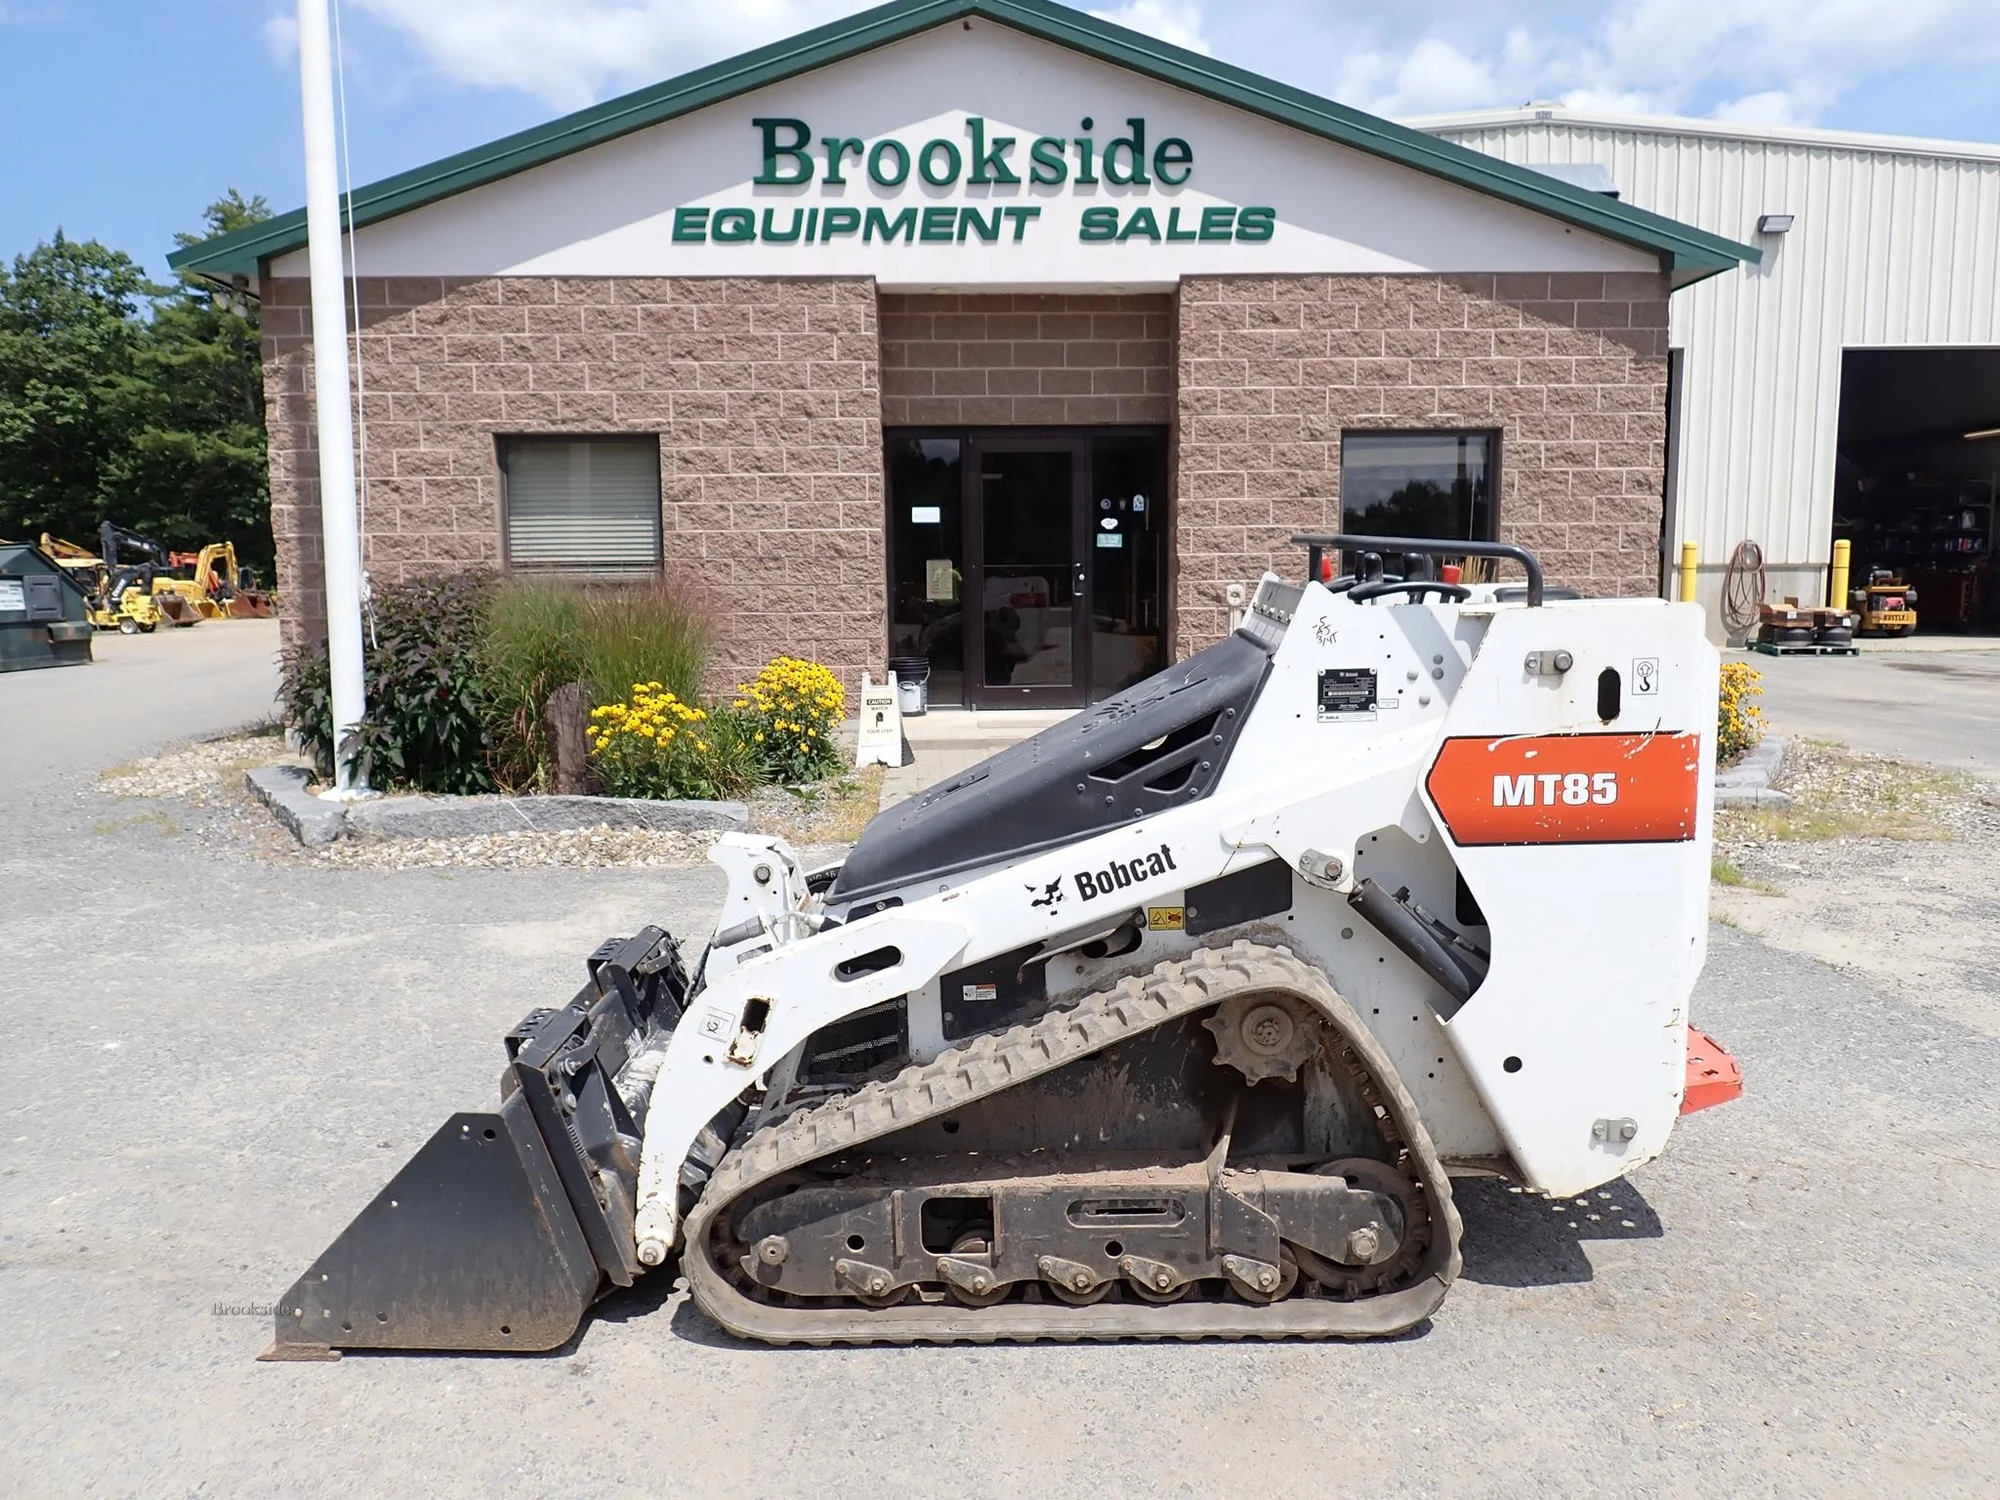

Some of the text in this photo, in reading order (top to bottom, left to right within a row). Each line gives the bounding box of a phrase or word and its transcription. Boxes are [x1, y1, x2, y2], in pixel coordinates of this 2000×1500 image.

[751, 116, 1194, 187] Brookside
[671, 206, 1276, 243] EQUIPMENT SALES
[1493, 772, 1618, 807] MT85
[1074, 844, 1177, 902] Bobcat
